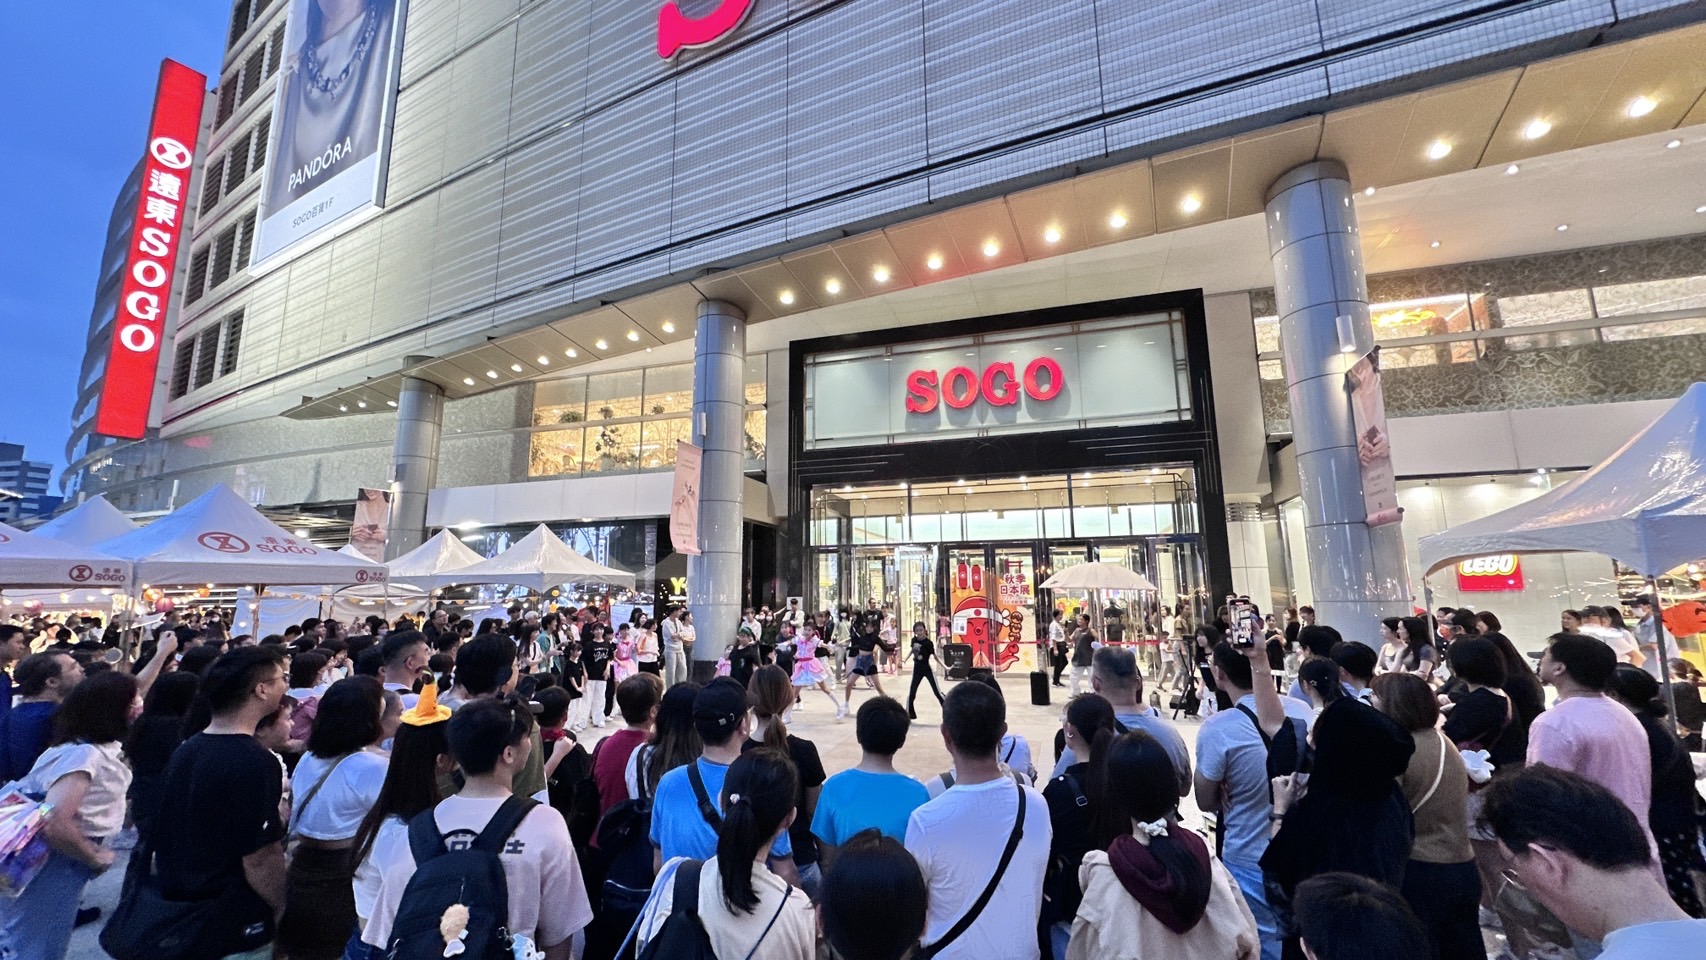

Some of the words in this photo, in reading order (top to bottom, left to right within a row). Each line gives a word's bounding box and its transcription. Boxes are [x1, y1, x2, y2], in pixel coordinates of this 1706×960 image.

[287, 136, 352, 192] PANDORA
[906, 357, 1065, 413] SOGO
[256, 543, 318, 555] SOGO
[1462, 554, 1515, 574] LEGO
[94, 572, 126, 582] SOGO
[1005, 573, 1026, 584] 秋季
[1000, 585, 1031, 595] 日本展
